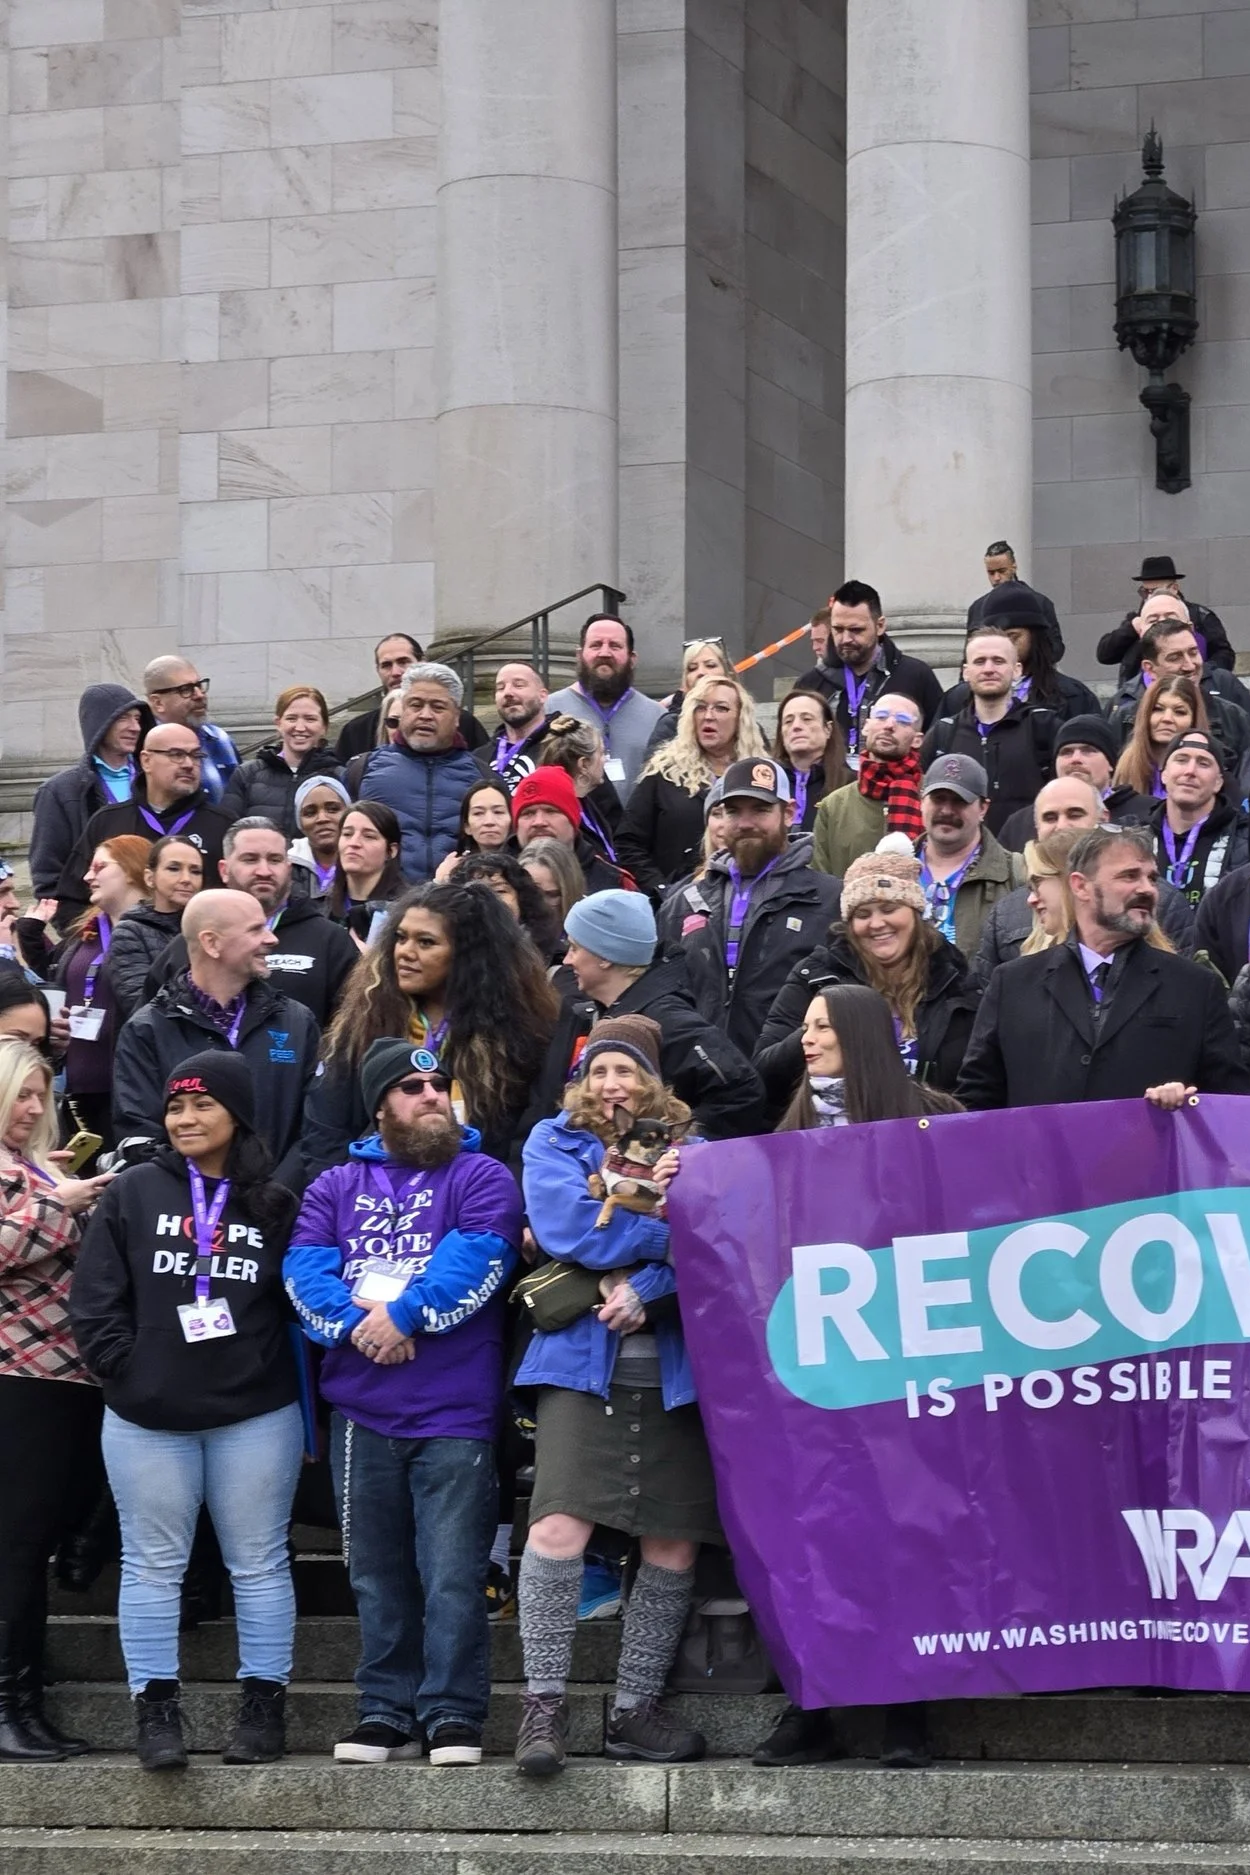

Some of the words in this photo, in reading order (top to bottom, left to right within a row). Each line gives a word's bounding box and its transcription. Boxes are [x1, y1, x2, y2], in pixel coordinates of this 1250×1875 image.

[346, 1232, 433, 1257] VOTE
[906, 1378, 956, 1419] IS
[983, 1360, 1232, 1412] POSSIBLE
